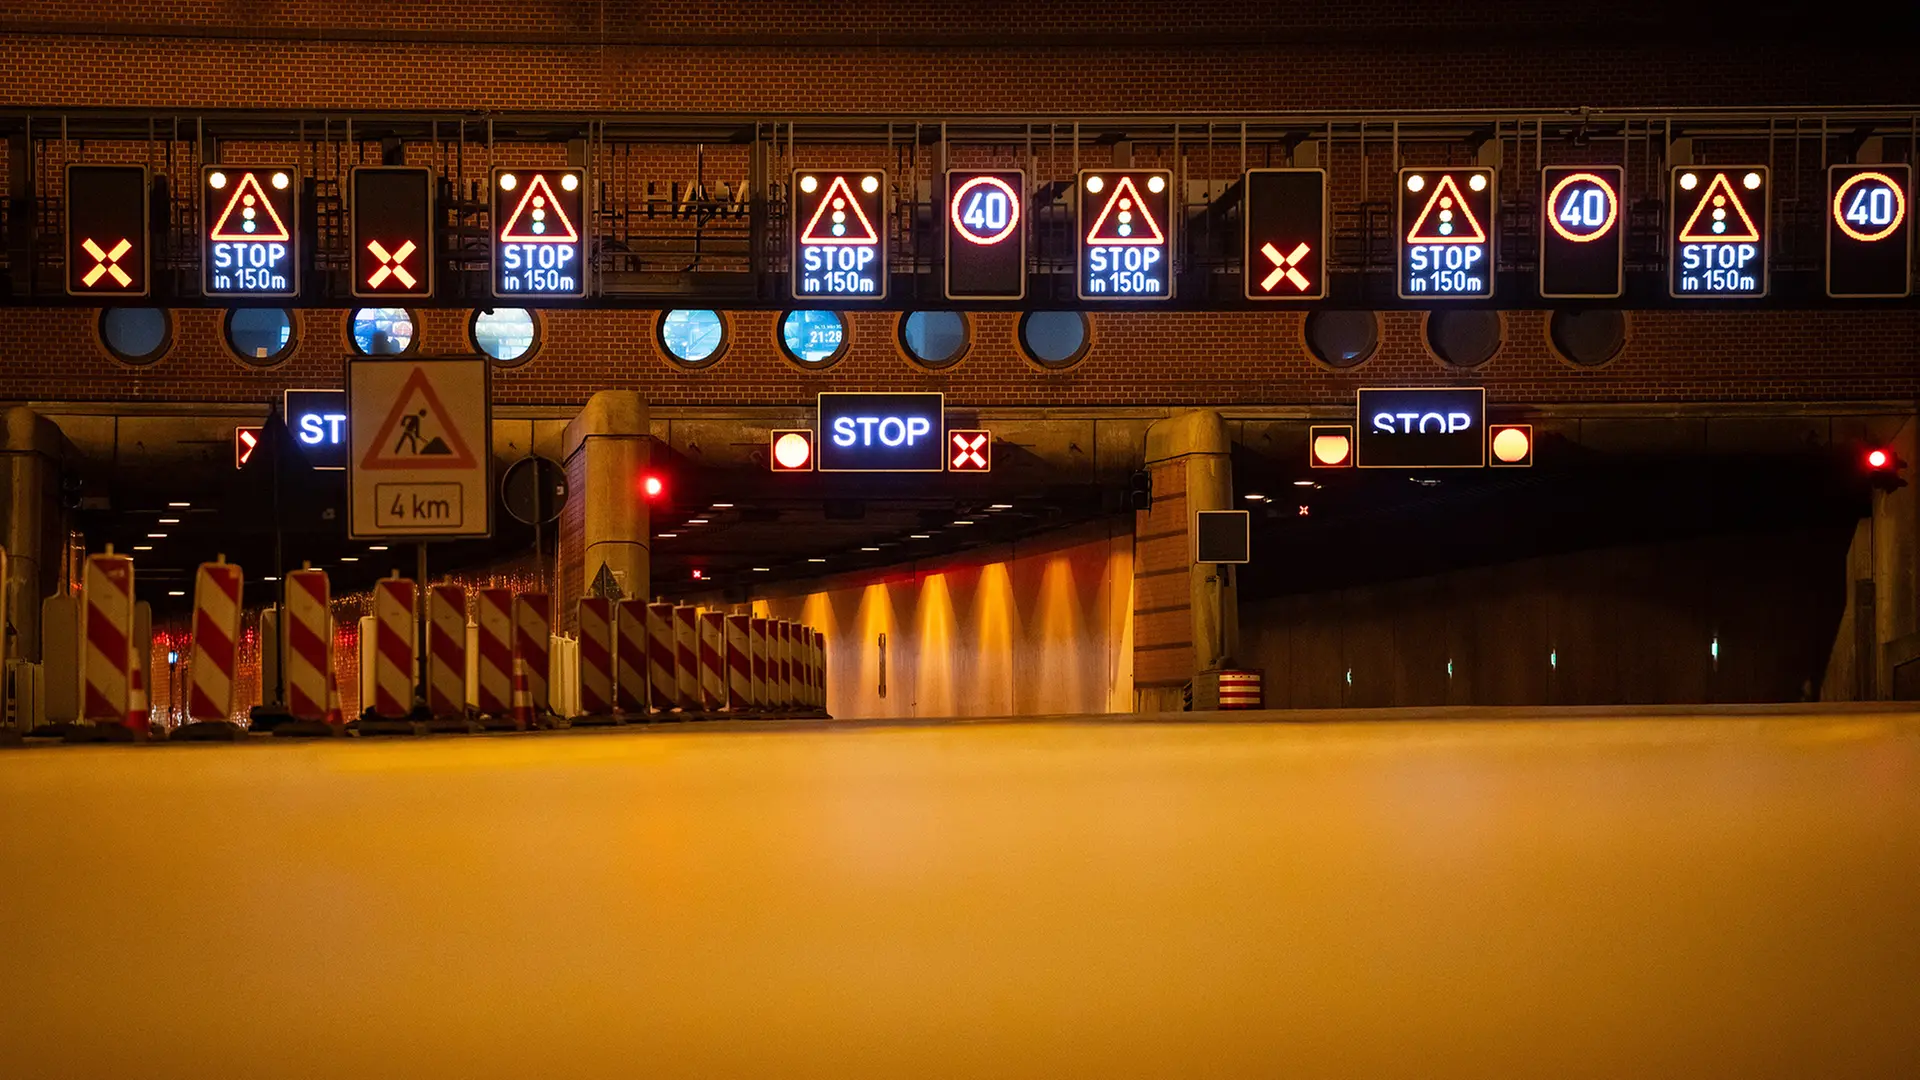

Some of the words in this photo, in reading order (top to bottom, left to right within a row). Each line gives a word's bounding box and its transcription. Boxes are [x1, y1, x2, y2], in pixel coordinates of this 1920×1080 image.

[963, 192, 1007, 229] 40
[1560, 189, 1604, 226] 40
[1846, 188, 1891, 225] 40
[214, 243, 286, 268] STOP
[504, 244, 576, 270] STOP
[804, 246, 876, 271] STOP
[1090, 246, 1161, 272] STOP
[1410, 245, 1482, 271] STOP
[1683, 244, 1756, 269] STOP
[215, 268, 231, 289] in
[234, 268, 286, 289] 150m
[504, 269, 520, 291] in
[523, 269, 574, 291] 150m
[804, 271, 820, 293] in
[823, 271, 875, 293] 150m
[1090, 271, 1106, 293] in
[1109, 271, 1160, 293] 150m
[1410, 270, 1427, 292] in
[1430, 270, 1482, 292] 150m
[1682, 269, 1699, 290] in
[1702, 269, 1755, 290] 150m
[810, 330, 842, 343] 21:28
[300, 413, 347, 444] ST
[833, 416, 930, 447] STOP
[1373, 412, 1471, 434] STOP
[391, 493, 404, 519] 4
[413, 493, 450, 519] km
